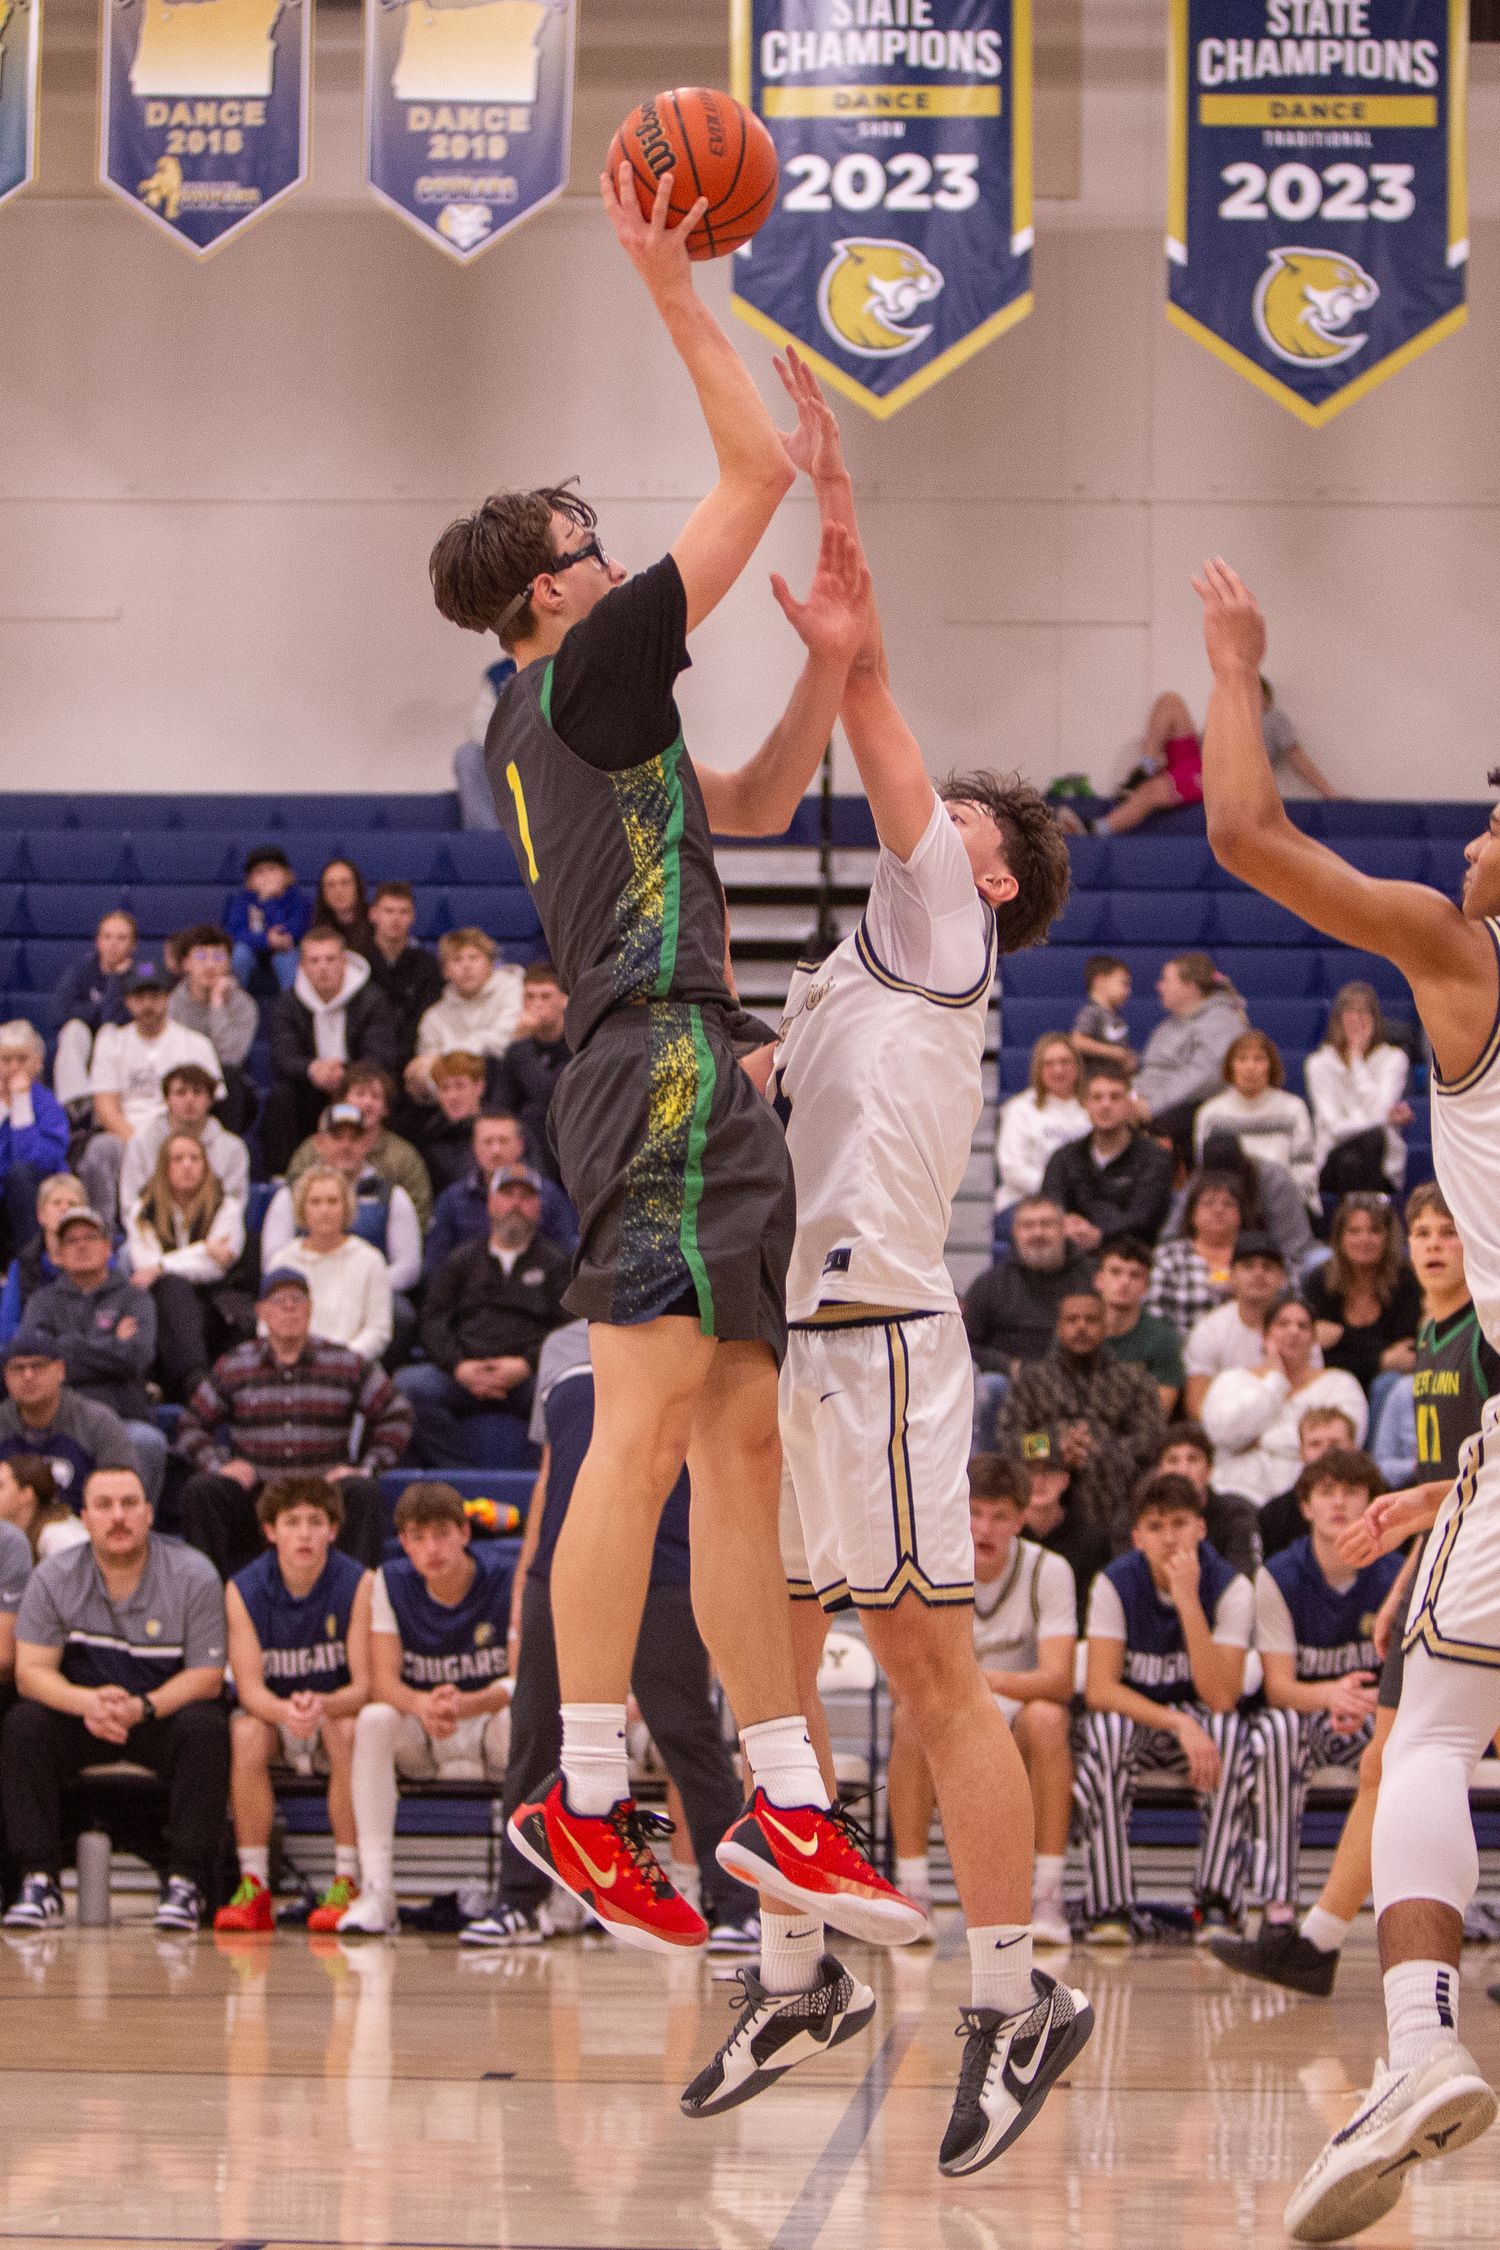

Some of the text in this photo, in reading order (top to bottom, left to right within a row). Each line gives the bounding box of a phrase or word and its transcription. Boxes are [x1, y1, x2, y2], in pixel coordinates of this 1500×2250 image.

[830, 0, 934, 27] STATE
[1266, 0, 1371, 37] STATE
[761, 30, 1002, 78] CHAMPIONS
[1198, 38, 1439, 87] CHAMPIONS
[144, 101, 267, 127] DANCE
[407, 106, 529, 132] DANCE
[832, 92, 930, 109] DANCE
[1269, 101, 1367, 119] DANCE
[782, 153, 980, 212] 2023
[1218, 161, 1416, 222] 2023
[506, 760, 540, 884] 1
[1416, 1404, 1441, 1462] 11
